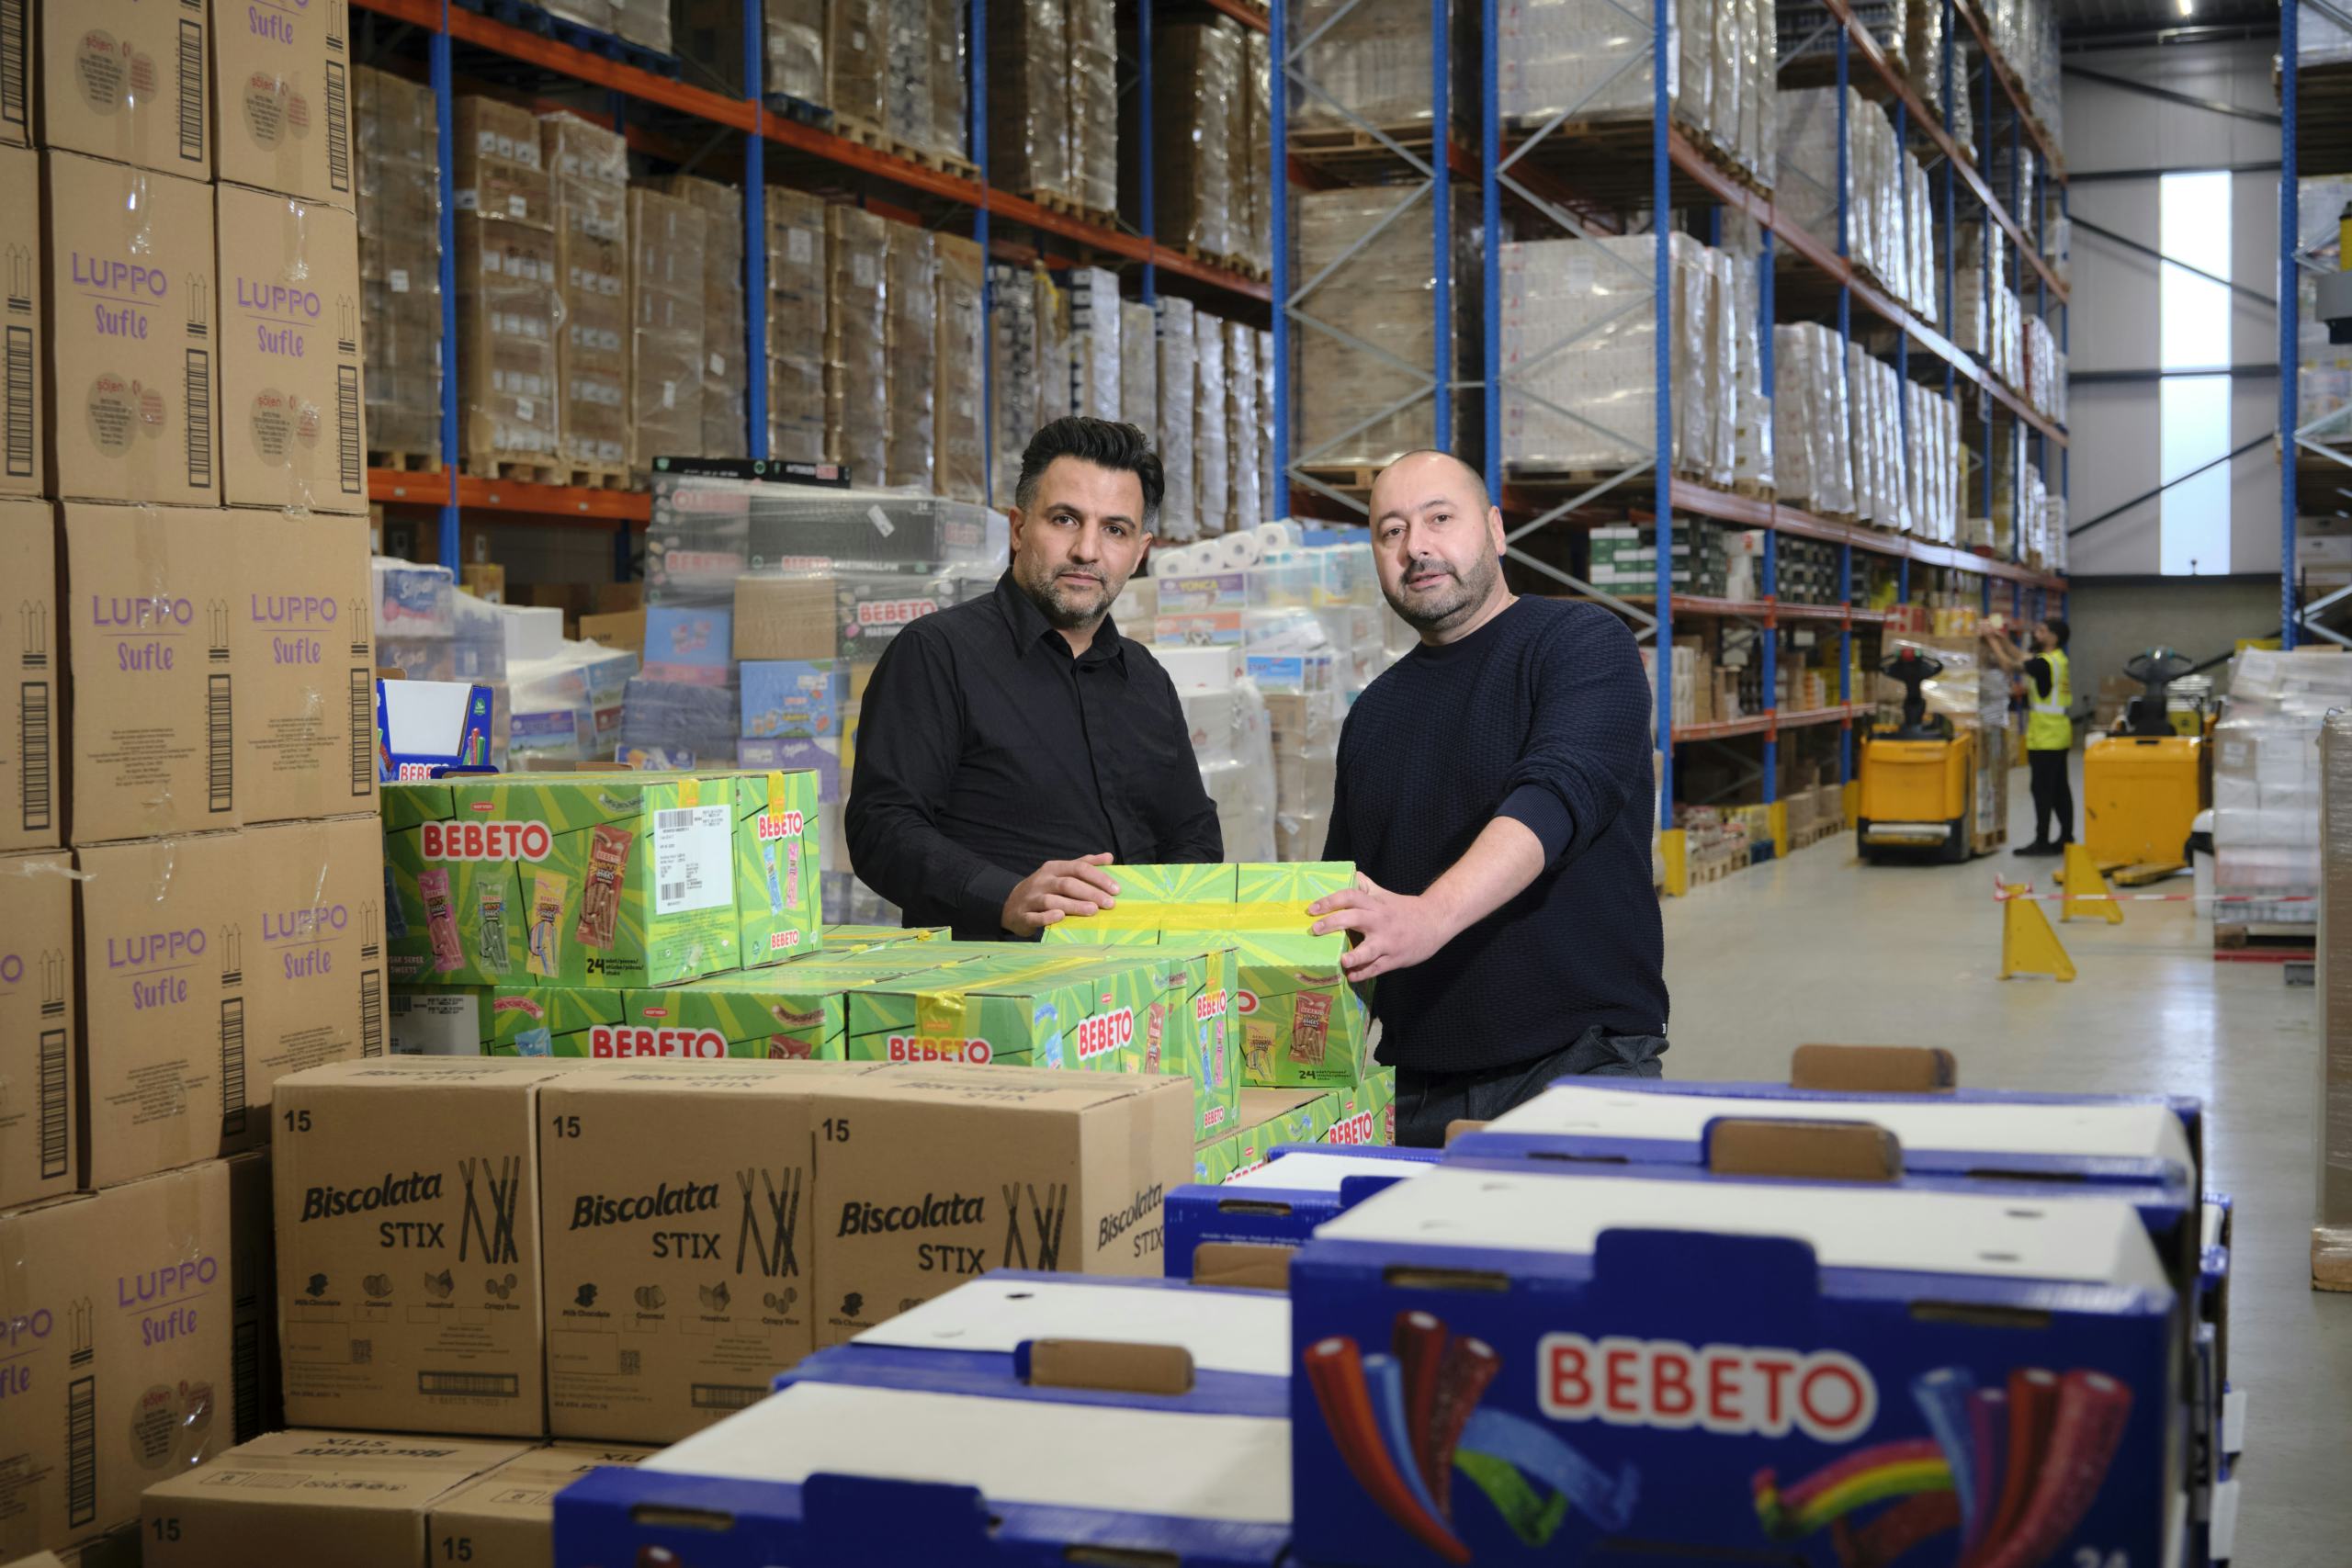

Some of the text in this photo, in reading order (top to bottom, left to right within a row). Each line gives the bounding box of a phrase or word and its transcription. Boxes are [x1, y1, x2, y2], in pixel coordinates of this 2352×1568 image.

[249, 5, 294, 45] Sufle
[71, 252, 167, 298] LUPPO
[237, 277, 321, 319] LUPPO
[96, 304, 148, 340] Sufle
[257, 324, 305, 358] Sufle
[93, 595, 193, 626] LUPPO
[252, 593, 336, 623] LUPPO
[119, 642, 174, 671] Sufle
[273, 637, 322, 665] Sufle
[423, 823, 549, 859] BEBETO
[760, 811, 803, 839] BEBETO
[262, 904, 348, 942] LUPPO
[107, 928, 206, 968] LUPPO
[771, 931, 799, 950] BEBETO
[285, 948, 332, 980] Sufle
[587, 958, 605, 974] 24
[133, 976, 187, 1010] Sufle
[1197, 990, 1227, 1019] BEBETO
[592, 1029, 726, 1059] BEBETO
[1079, 1010, 1133, 1057] BEBETO
[888, 1037, 991, 1064] BEBETO
[1298, 1070, 1316, 1079] 24
[284, 1110, 312, 1132] 15
[552, 1116, 582, 1138] 15
[822, 1119, 850, 1142] 15
[1204, 1107, 1224, 1126] BEBETO
[1329, 1112, 1373, 1145] BEBETO
[300, 1171, 443, 1222] Biscolata
[570, 1180, 720, 1230] Biscolata
[838, 1192, 986, 1237] Biscolata
[1097, 1182, 1162, 1252] Biscolata
[379, 1222, 446, 1248] STIX
[652, 1233, 721, 1260] STIX
[1134, 1225, 1163, 1258] STIX
[919, 1244, 986, 1275] STIX
[119, 1257, 218, 1308] LUPPO
[141, 1307, 198, 1348] Sufle
[0, 1366, 30, 1398] fle
[1545, 1341, 1868, 1433] BEBETO
[151, 1517, 182, 1542] 15
[442, 1538, 473, 1562] 15
